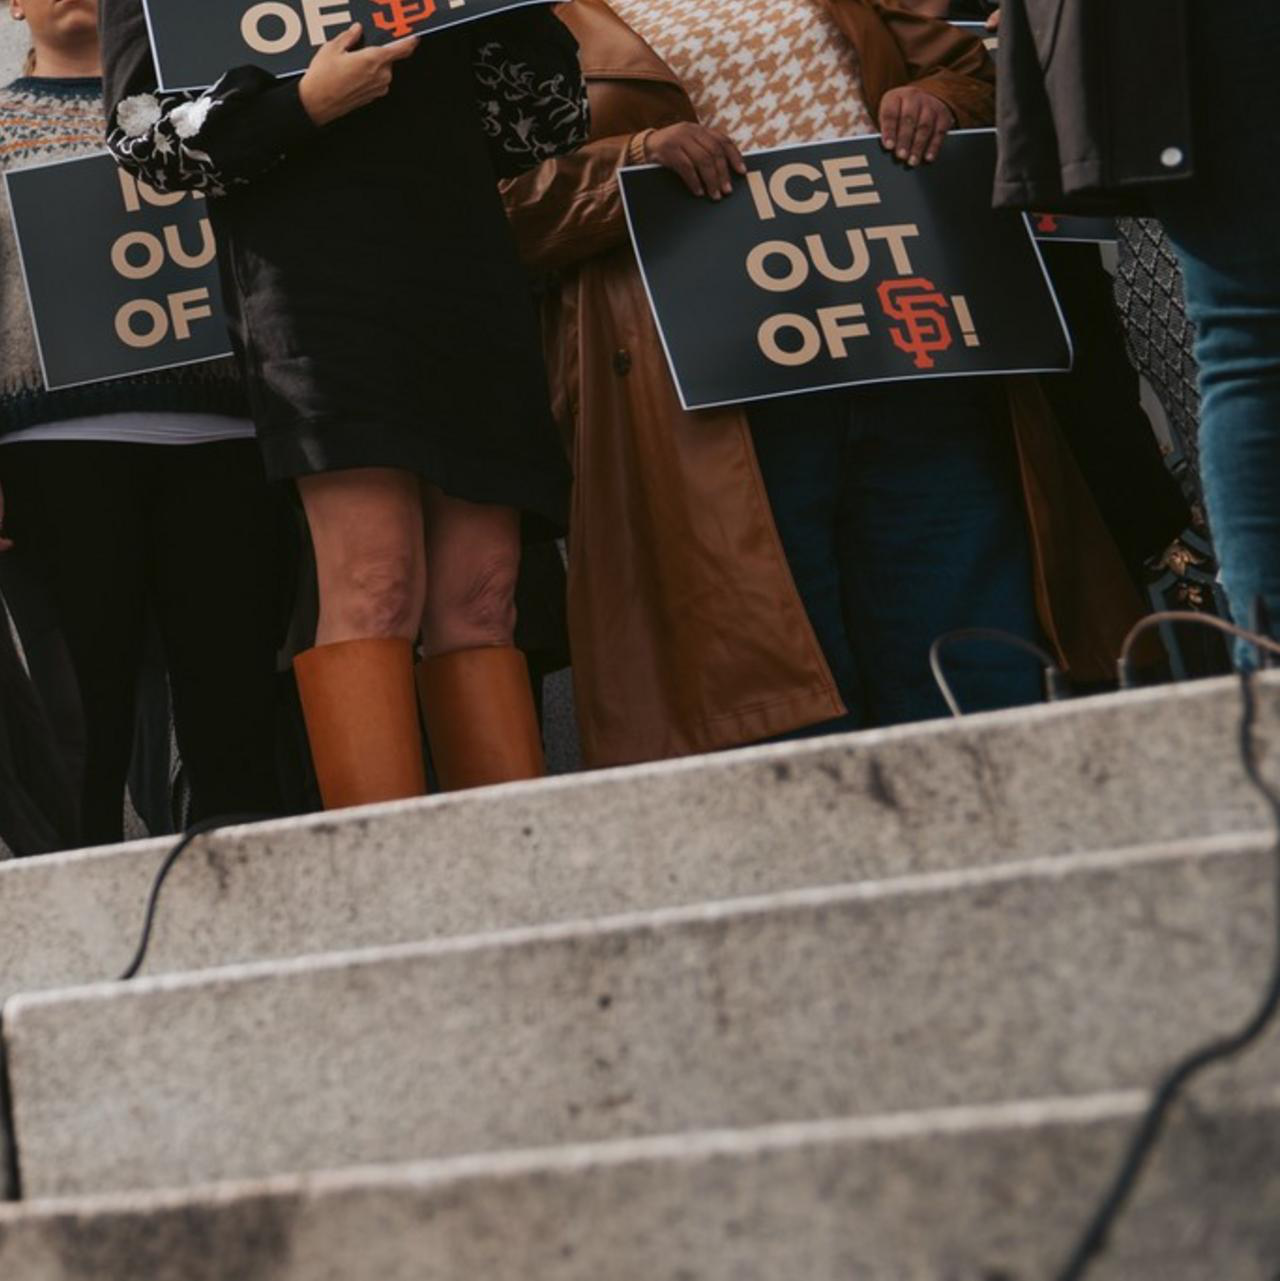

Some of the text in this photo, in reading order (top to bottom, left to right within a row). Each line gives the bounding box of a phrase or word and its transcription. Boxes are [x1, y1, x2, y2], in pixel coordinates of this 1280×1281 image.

[746, 155, 881, 219] ICE
[111, 218, 217, 280] OU
[746, 224, 920, 292] OUT
[114, 287, 212, 348] OF
[757, 304, 869, 366] OF
